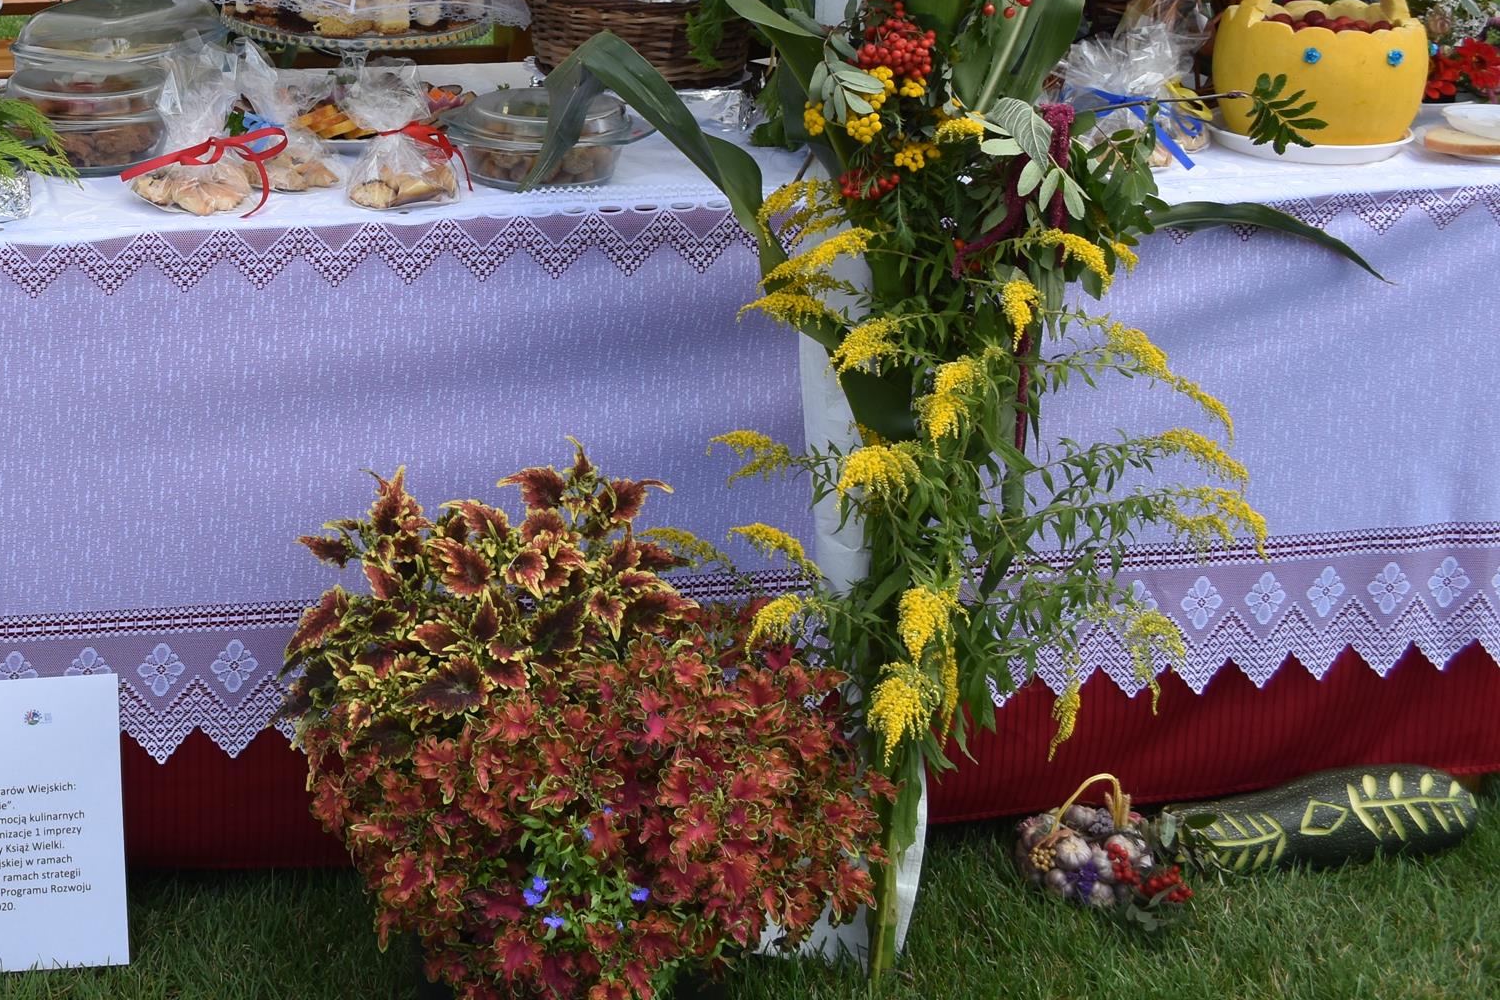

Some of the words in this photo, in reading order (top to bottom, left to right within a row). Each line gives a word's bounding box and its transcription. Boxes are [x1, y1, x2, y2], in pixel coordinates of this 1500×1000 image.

[27, 782, 76, 795] Wiejskich:
[29, 810, 85, 822] kulinarnych
[35, 827, 40, 837] 1
[43, 826, 82, 837] imprezy
[5, 842, 30, 854] Książ
[31, 840, 65, 851] Wielki.
[36, 854, 72, 865] ramach
[3, 871, 39, 882] ramach
[41, 868, 81, 880] strategii
[0, 887, 48, 898] Programu
[50, 882, 91, 893] Rozwoju
